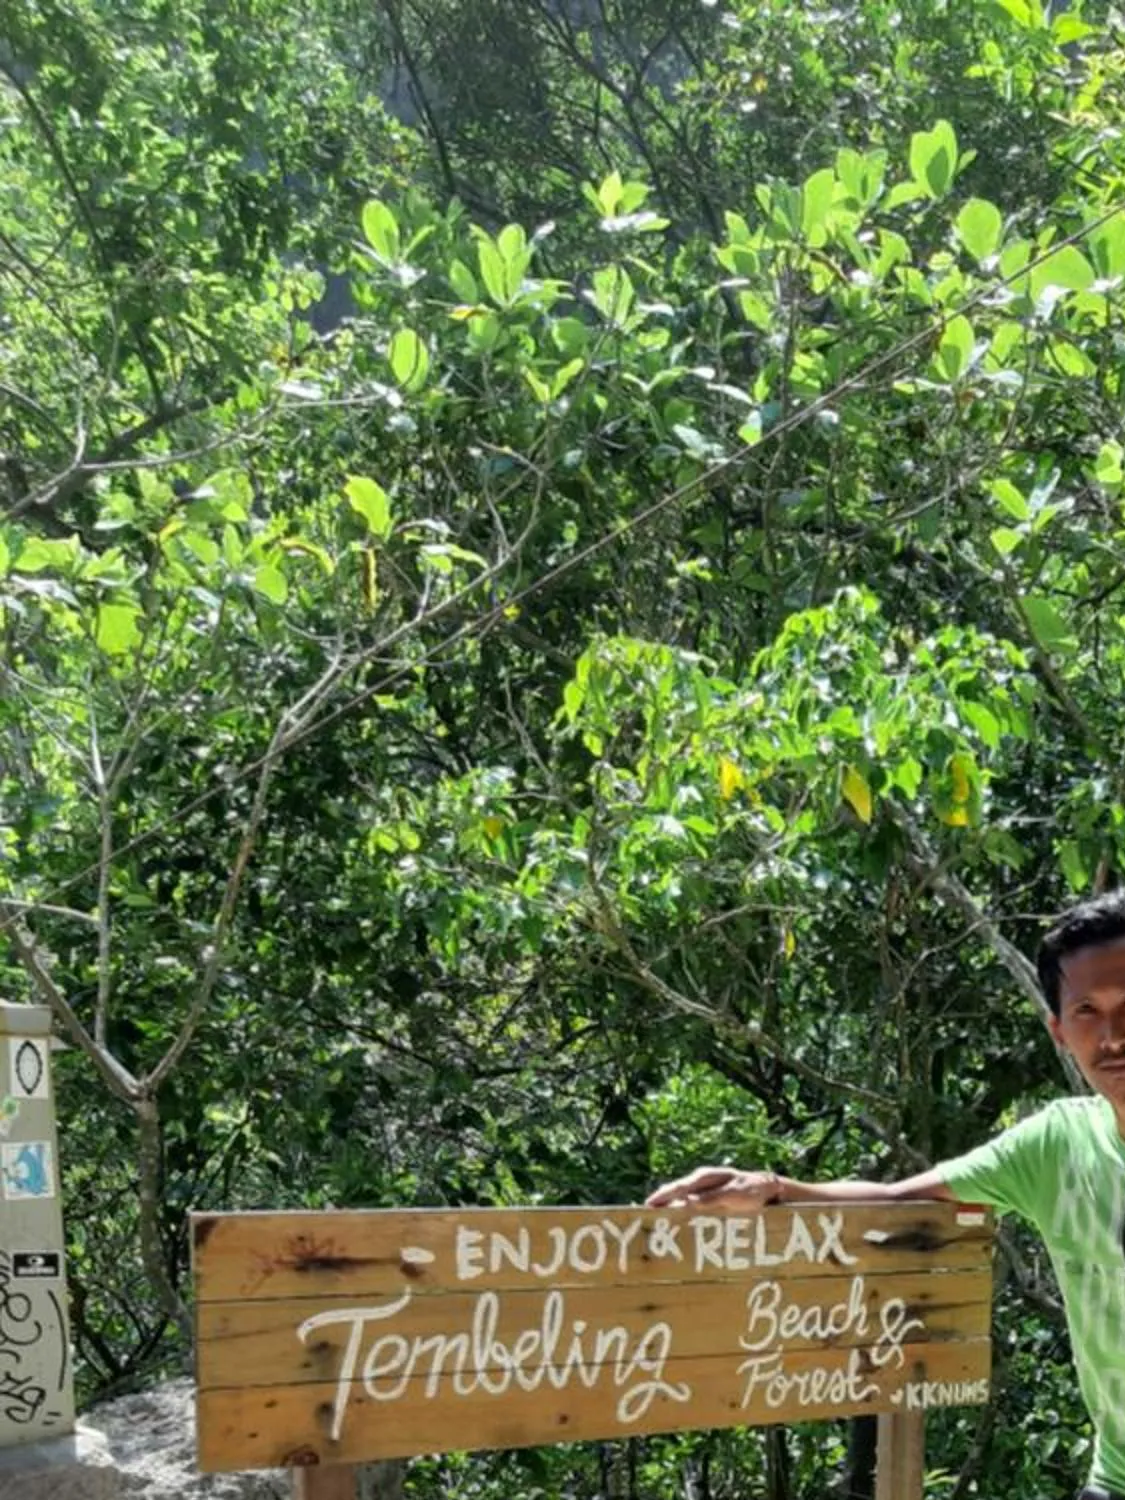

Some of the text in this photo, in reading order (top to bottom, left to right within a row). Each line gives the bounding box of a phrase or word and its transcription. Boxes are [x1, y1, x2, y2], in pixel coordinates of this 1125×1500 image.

[456, 1211, 859, 1281] ENJOY & RELAX
[296, 1285, 692, 1441] Tembeling
[738, 1275, 925, 1370] Beach &
[735, 1343, 881, 1409] Forest
